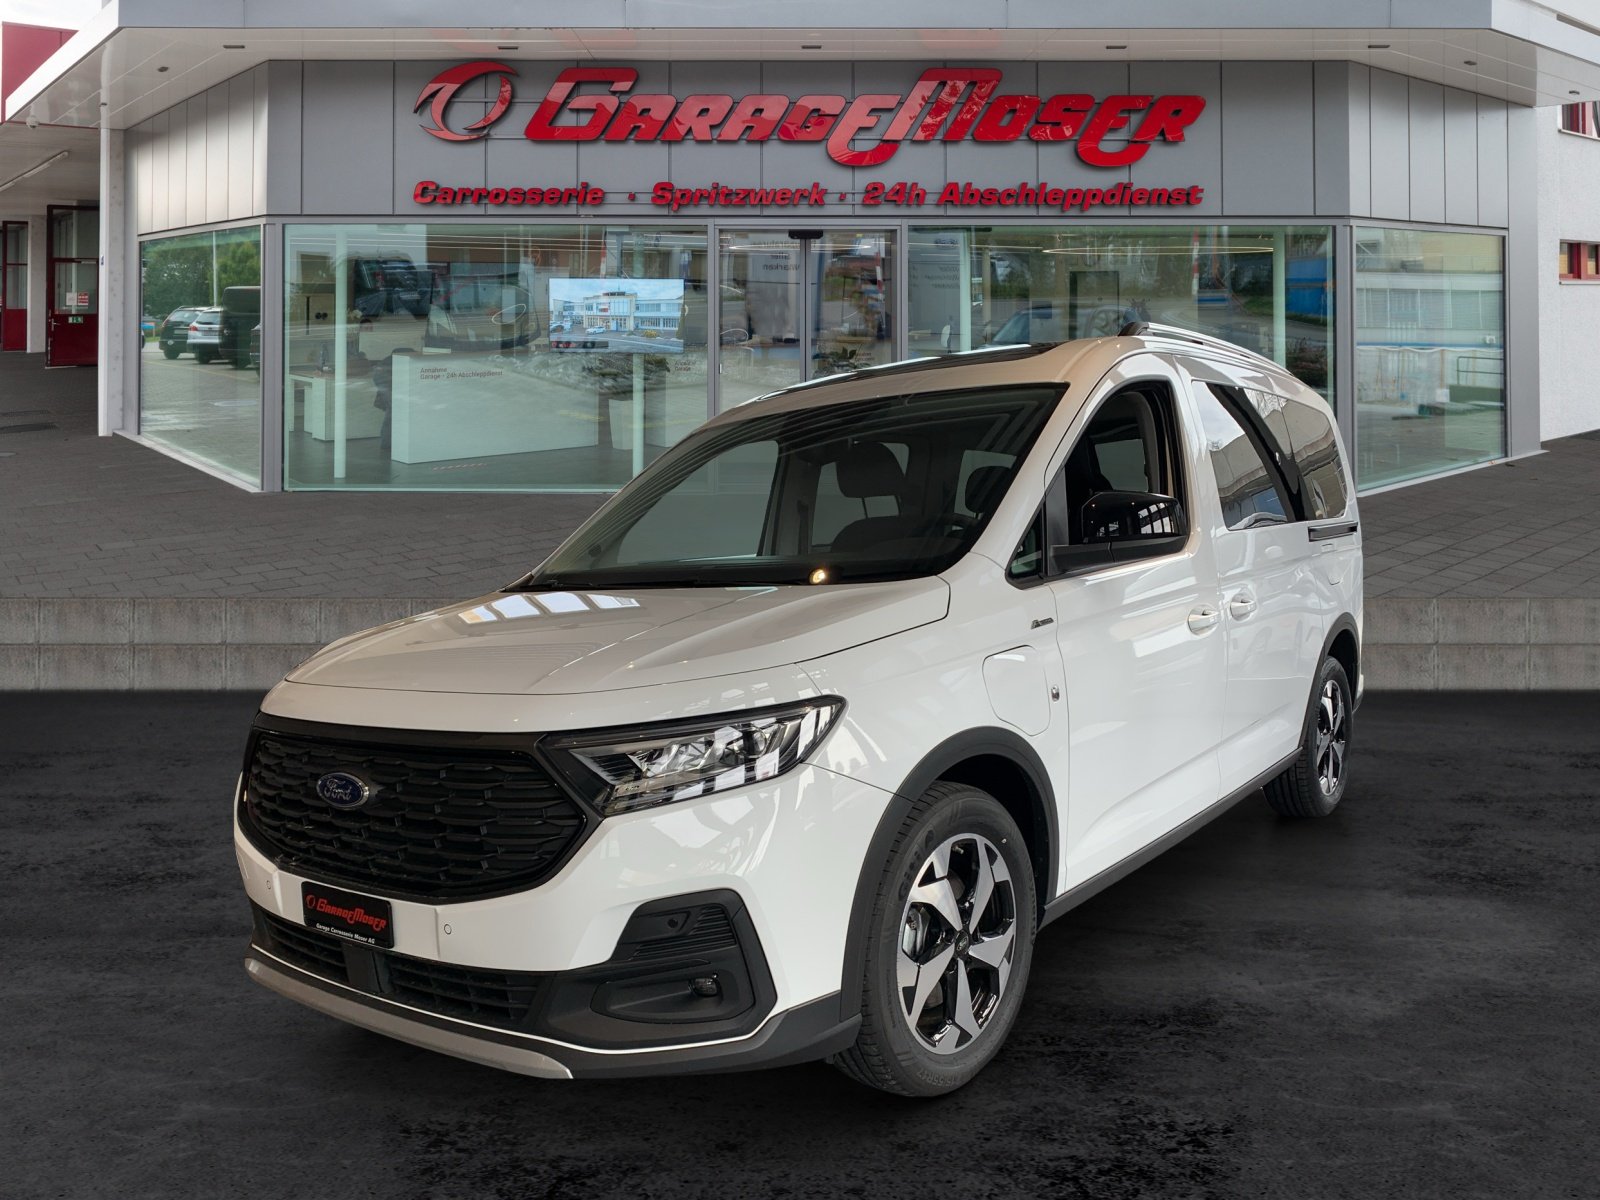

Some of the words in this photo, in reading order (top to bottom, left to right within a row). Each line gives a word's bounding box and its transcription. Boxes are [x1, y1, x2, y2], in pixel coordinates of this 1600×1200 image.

[413, 180, 605, 206] Carrosserie
[651, 181, 827, 211] Spritzwerk
[863, 181, 927, 207] 24h
[937, 181, 1205, 212] Abschleppdienst
[315, 922, 330, 932] Garage
[353, 933, 368, 942] Moser
